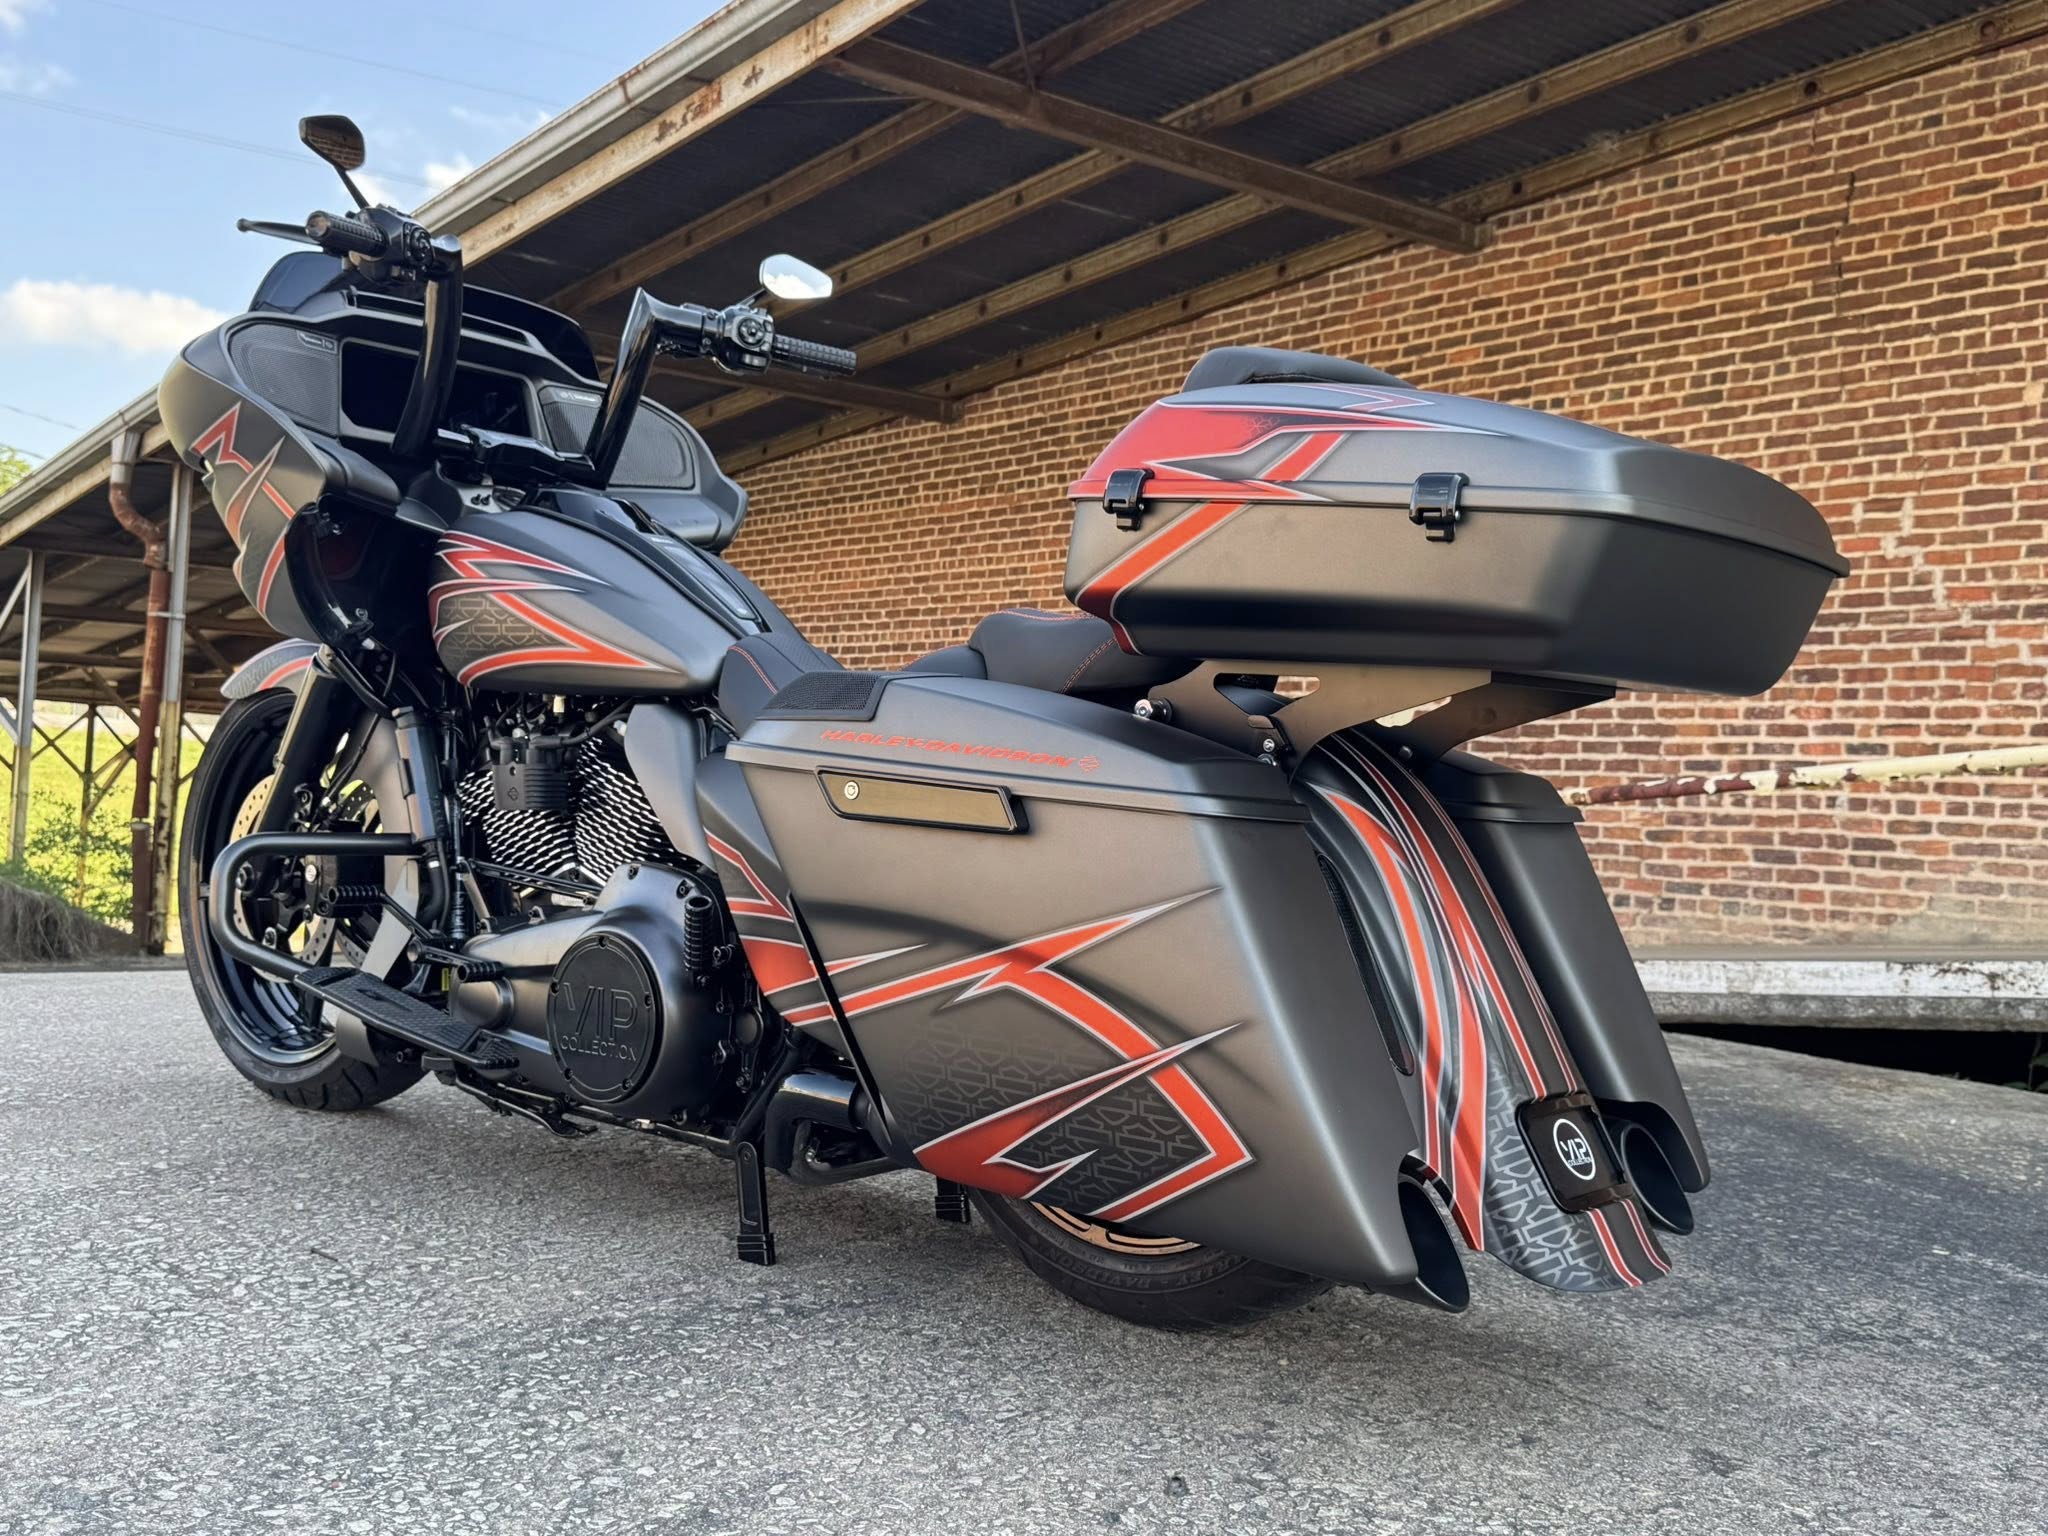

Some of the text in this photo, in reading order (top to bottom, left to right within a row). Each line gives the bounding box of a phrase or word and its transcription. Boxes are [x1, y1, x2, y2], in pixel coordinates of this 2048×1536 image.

[820, 729, 1076, 768] HARLEY-DAVIDSON
[563, 982, 638, 1040] VIP
[1560, 1138, 1587, 1159] VIP
